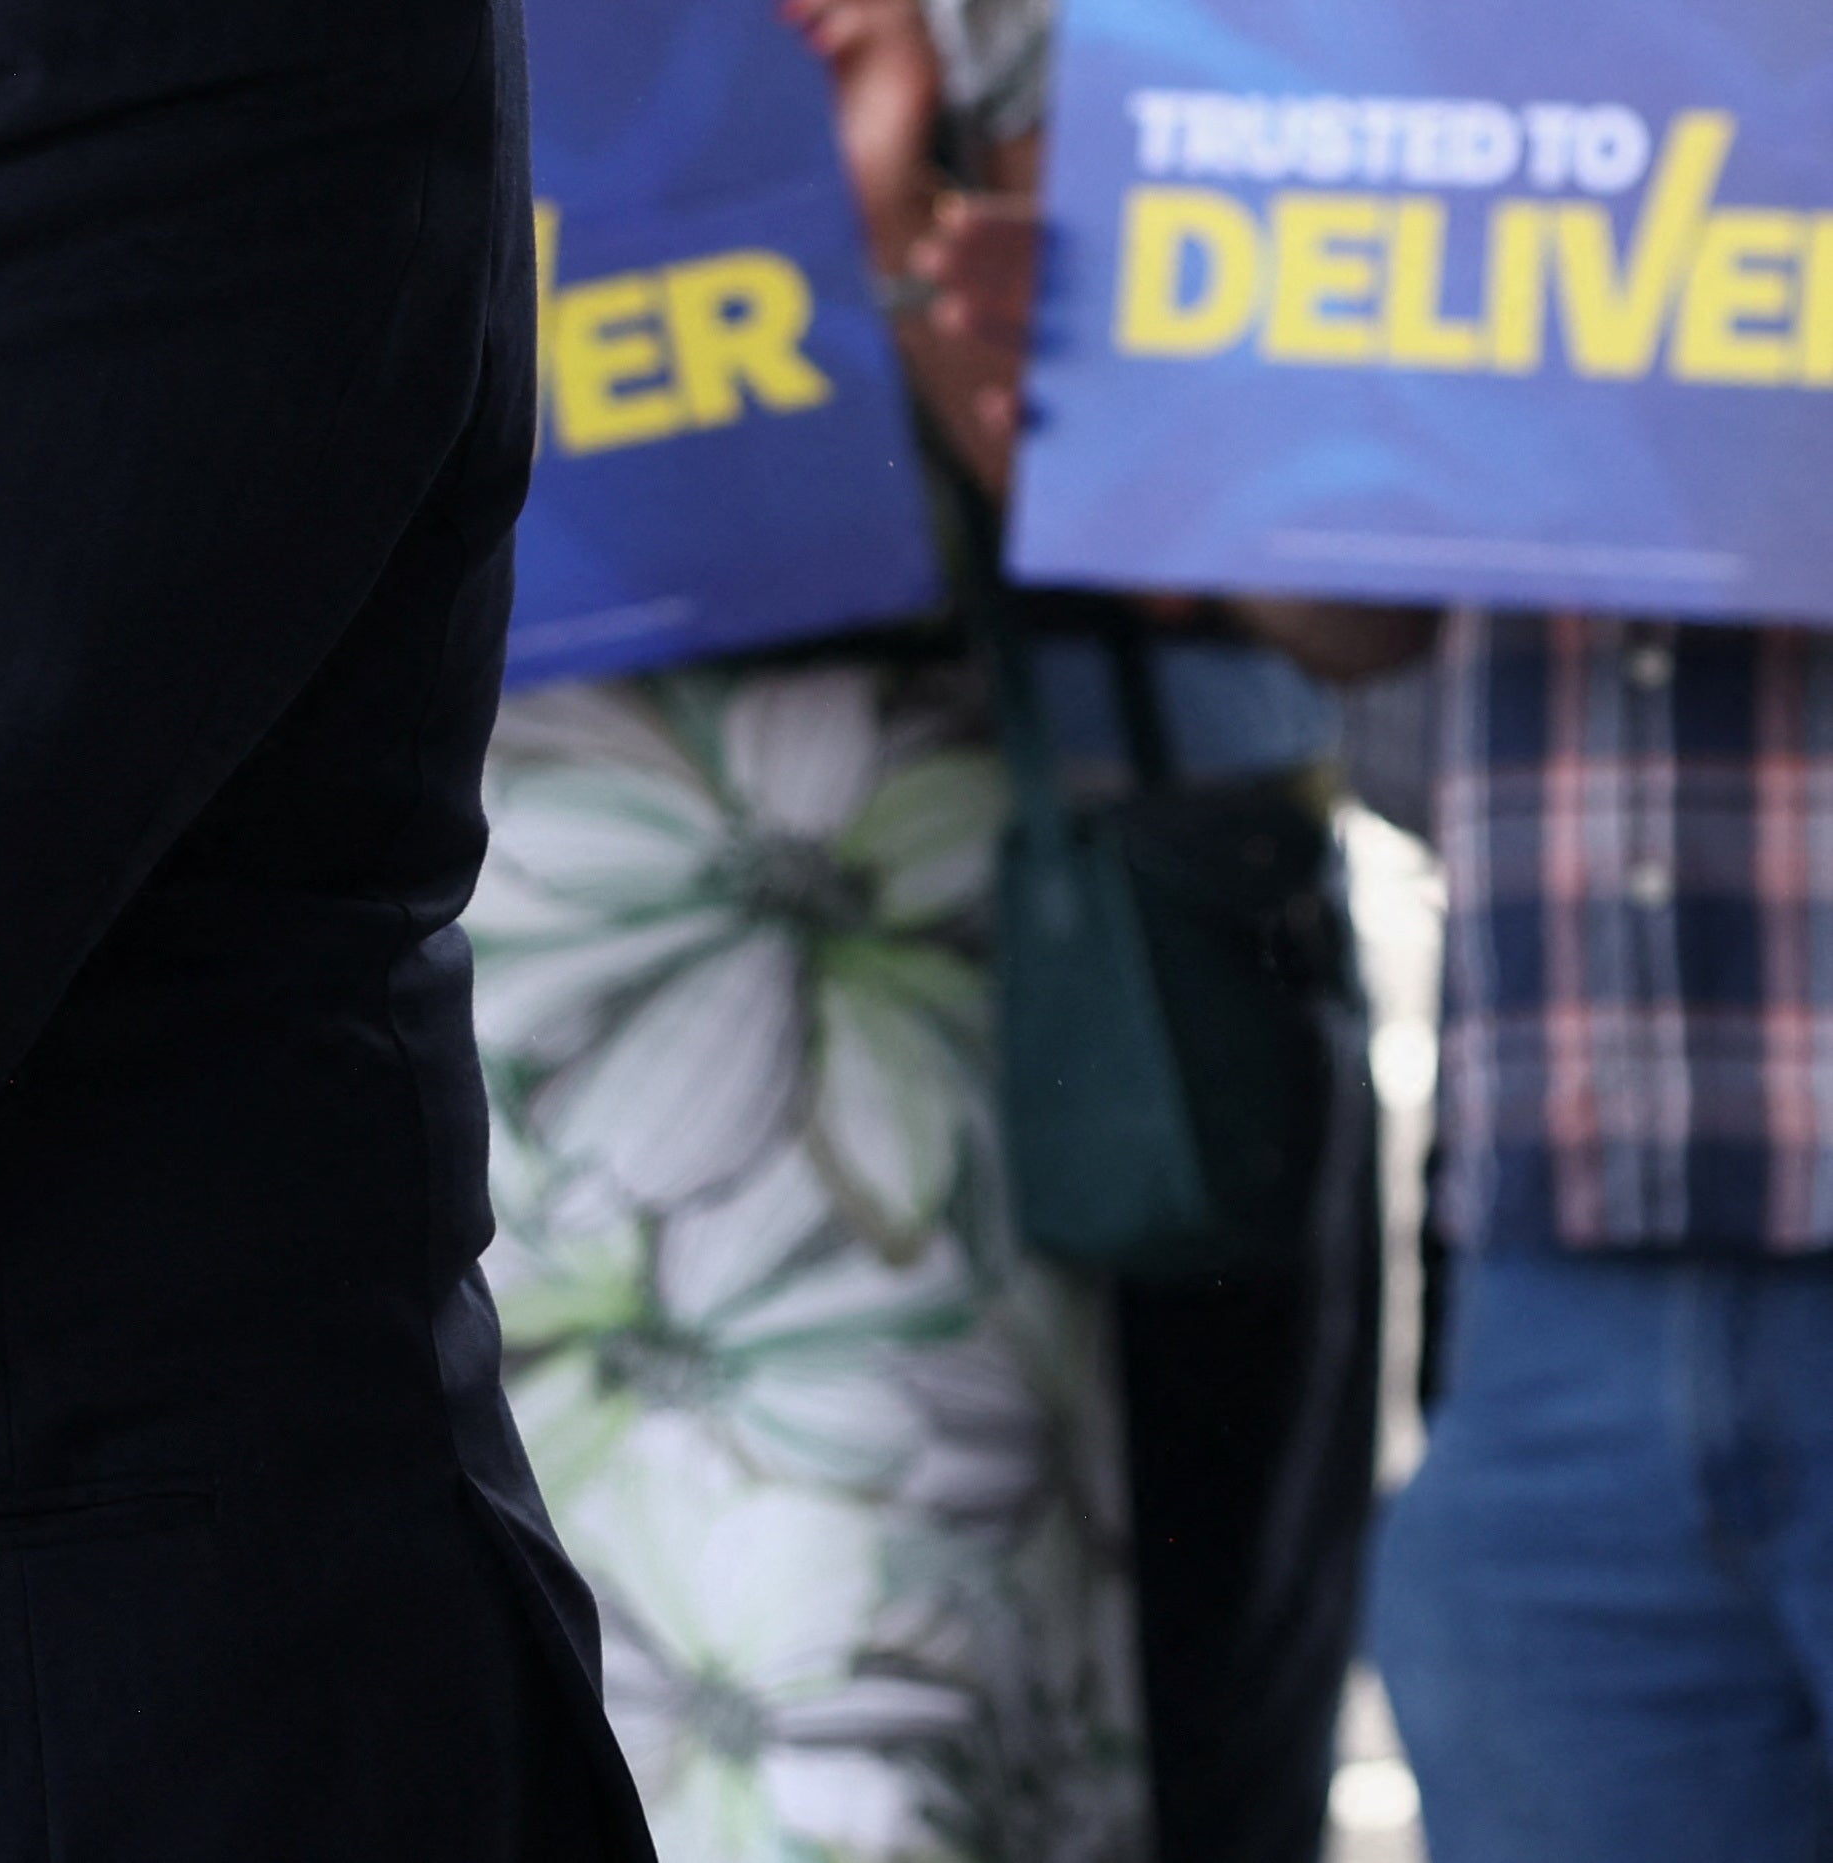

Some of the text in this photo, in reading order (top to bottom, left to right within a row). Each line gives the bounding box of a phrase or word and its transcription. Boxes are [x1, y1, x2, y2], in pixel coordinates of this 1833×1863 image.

[1115, 108, 1833, 390] DELIVE
[1131, 89, 1648, 192] TRUSTED TO
[535, 200, 833, 457] ER
